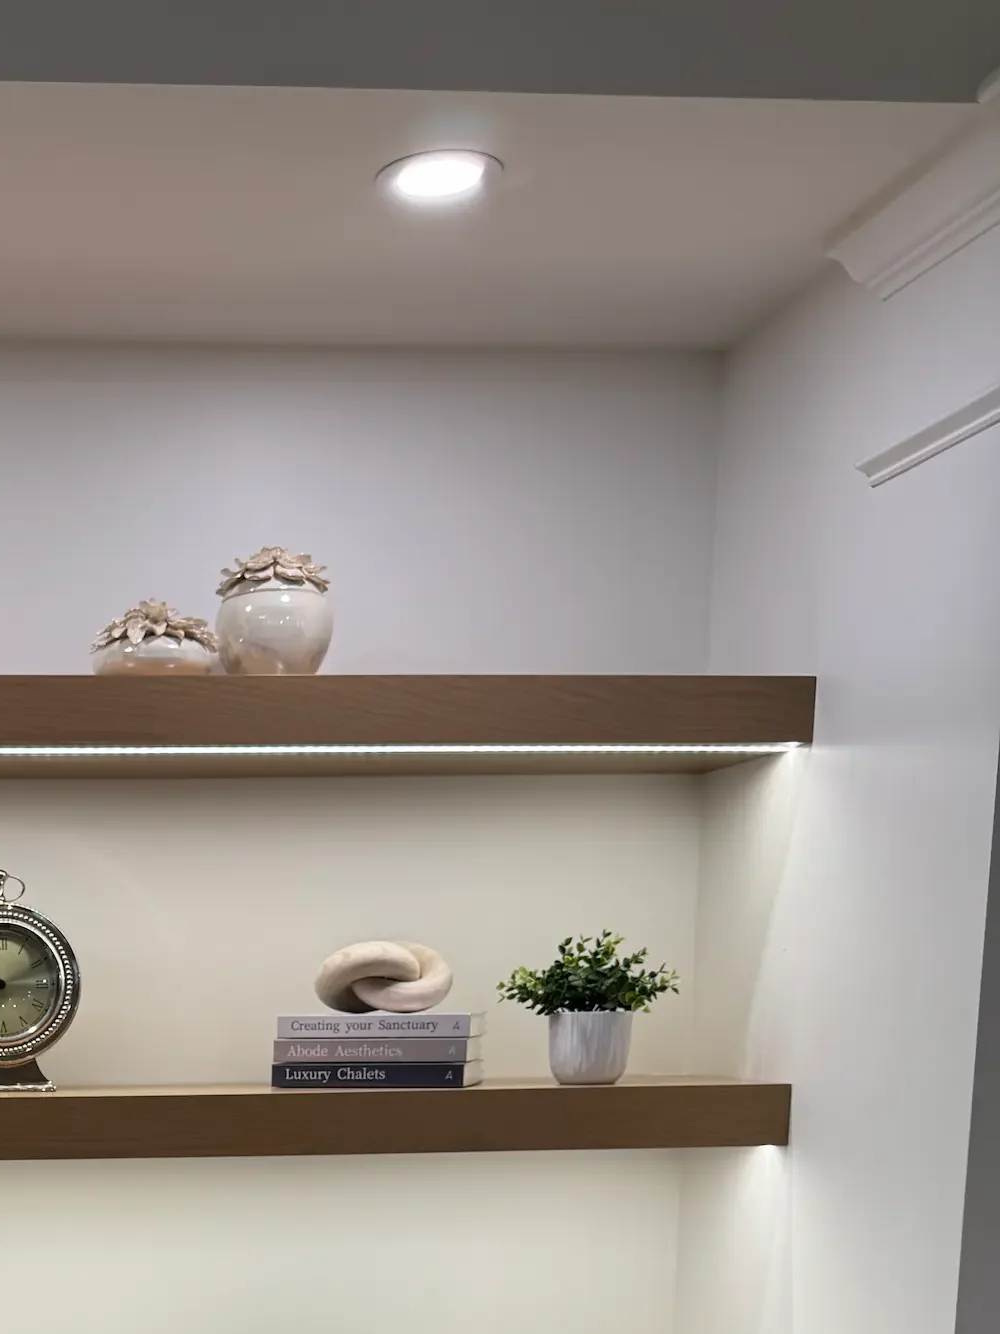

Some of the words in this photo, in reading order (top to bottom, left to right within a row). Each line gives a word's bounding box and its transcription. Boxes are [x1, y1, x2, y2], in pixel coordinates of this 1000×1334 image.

[290, 1020, 341, 1034] Creating
[345, 1021, 373, 1034] your
[378, 1019, 438, 1033] Sanctuary
[287, 1043, 329, 1057] Abode
[335, 1043, 402, 1057] Aesthetics
[285, 1067, 331, 1083] Luxury
[337, 1067, 386, 1080] Chalets
